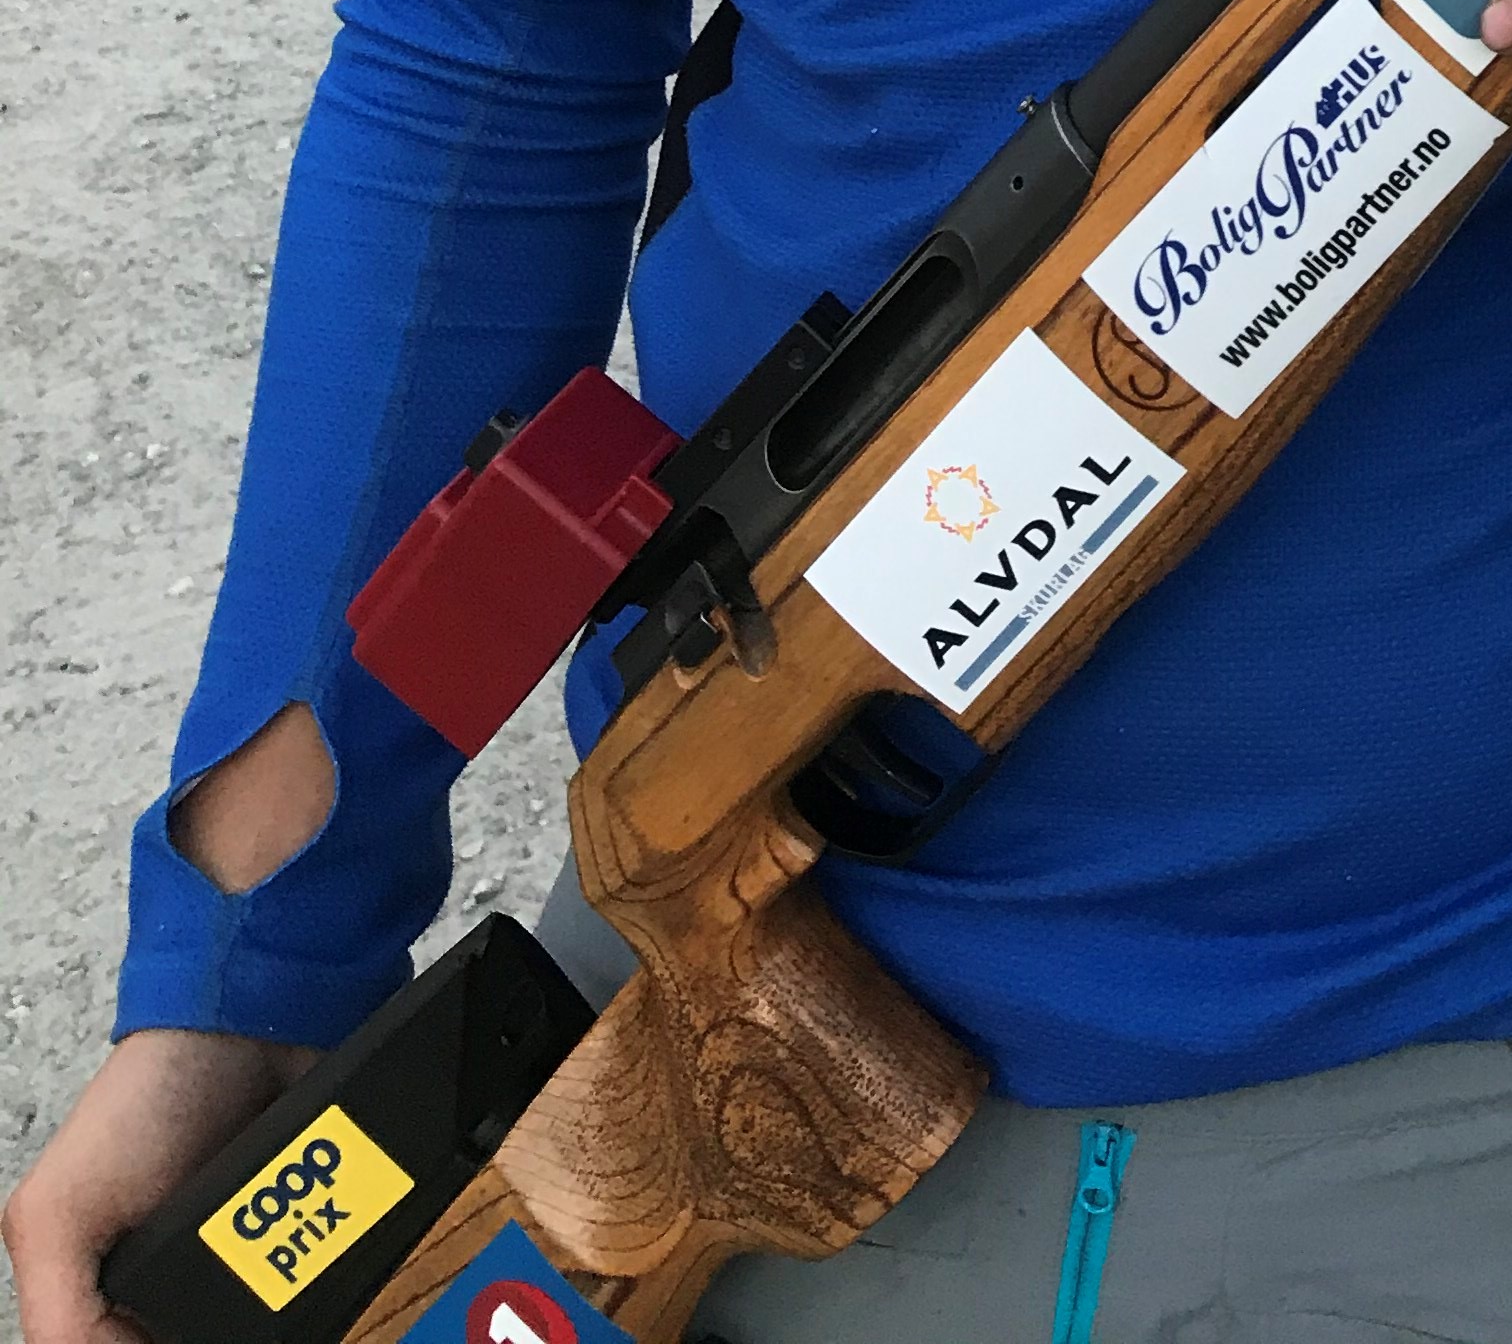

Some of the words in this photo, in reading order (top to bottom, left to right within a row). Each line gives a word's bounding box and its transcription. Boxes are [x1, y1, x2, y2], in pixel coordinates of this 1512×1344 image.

[1220, 127, 1452, 368] www.boligpartner.no
[922, 455, 1132, 670] ALVDAL
[1018, 546, 1092, 624] SKURLAG
[232, 1138, 341, 1241] coop
[265, 1197, 352, 1284] prix
